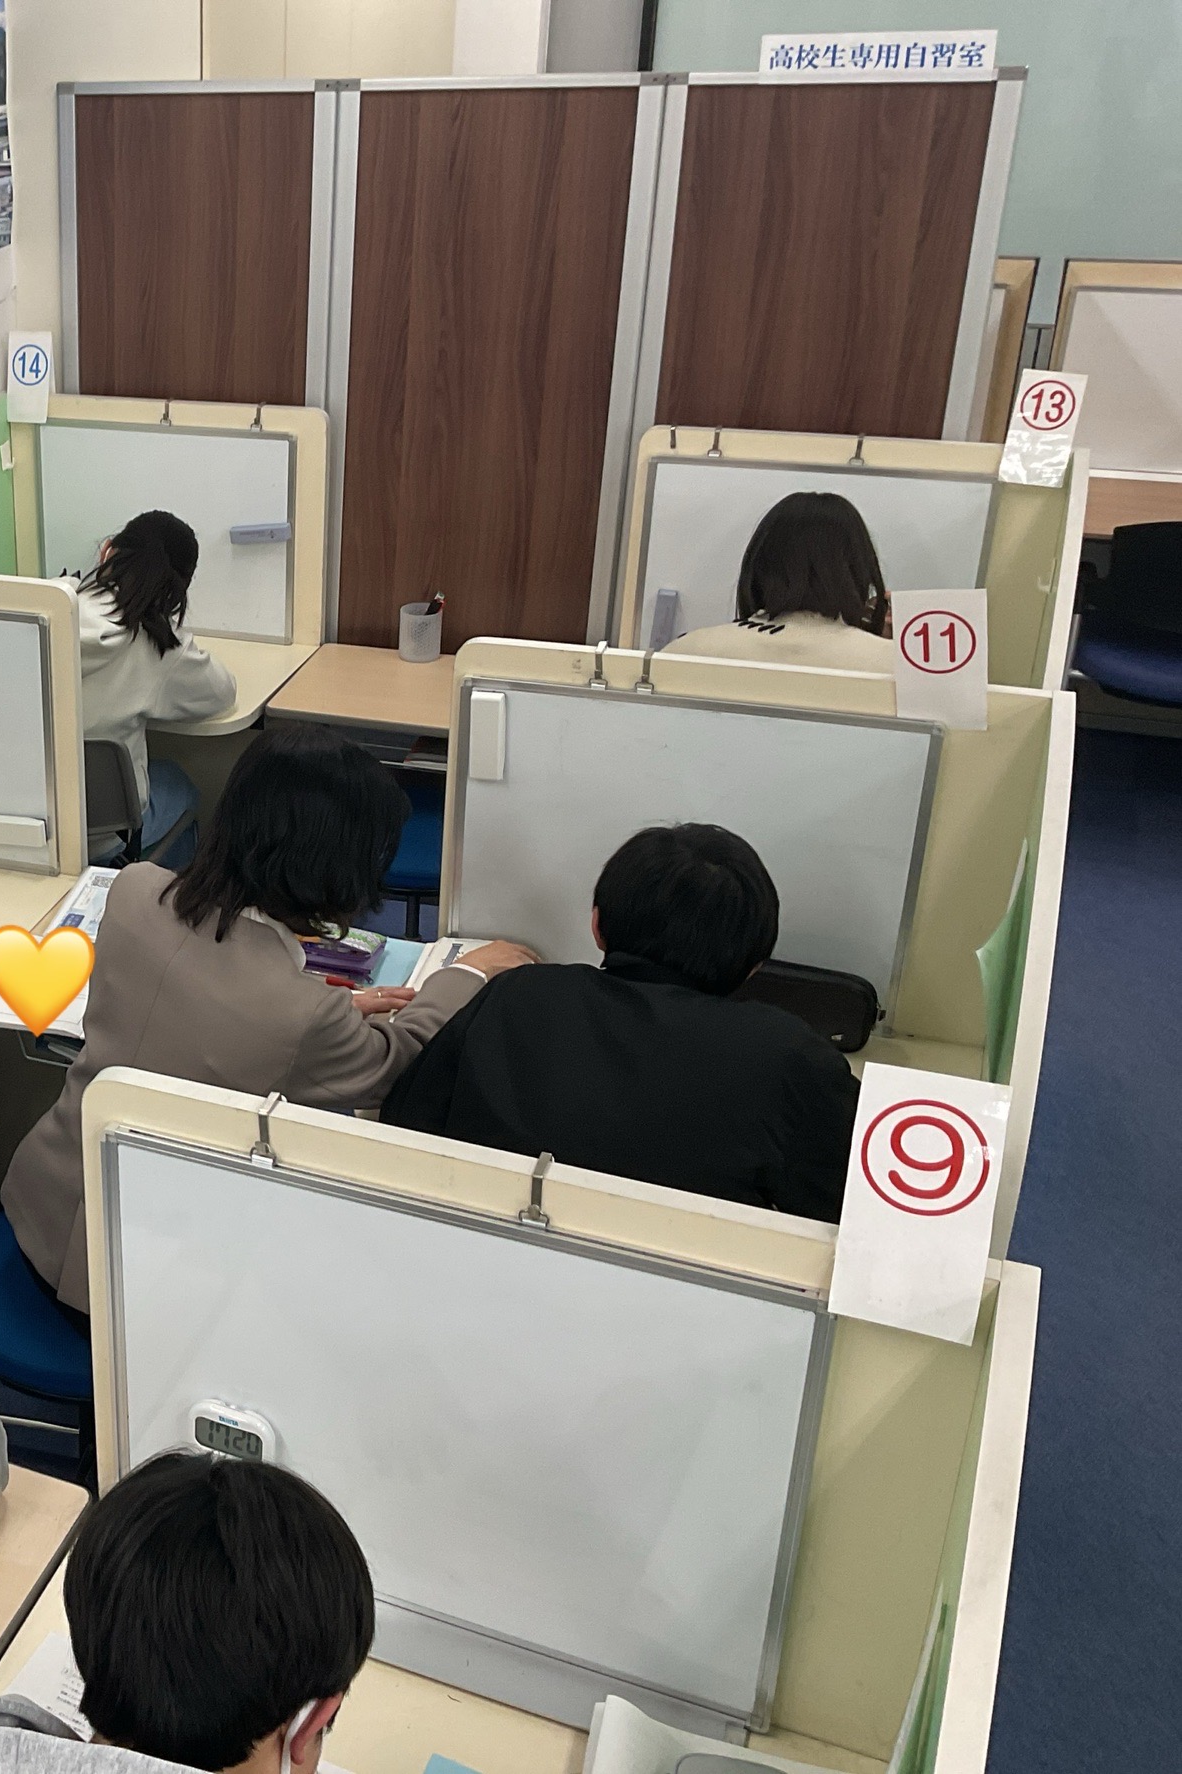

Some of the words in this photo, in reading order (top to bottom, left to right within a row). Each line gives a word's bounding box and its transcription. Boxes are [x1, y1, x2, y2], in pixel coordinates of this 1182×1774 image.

[768, 41, 987, 71] 高校生専用自習室
[18, 352, 42, 379] 14
[1031, 388, 1066, 423] 13
[913, 622, 957, 663] 11
[888, 1115, 965, 1200] 9
